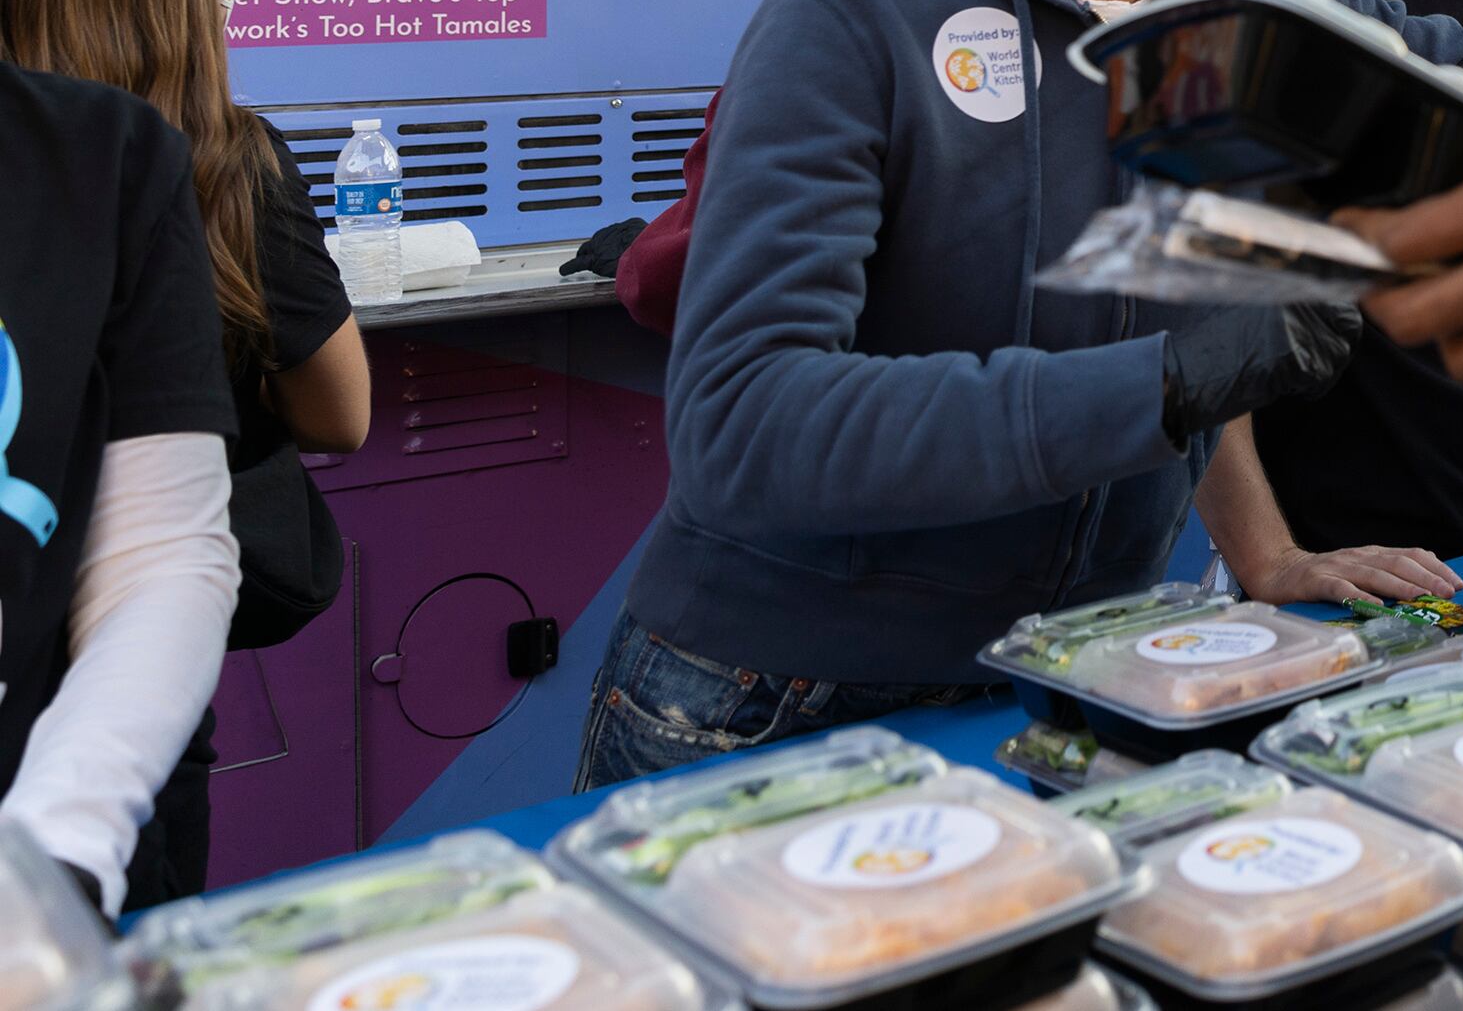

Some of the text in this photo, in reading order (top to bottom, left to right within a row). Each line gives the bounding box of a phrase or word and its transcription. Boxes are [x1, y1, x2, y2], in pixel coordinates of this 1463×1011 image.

[227, 11, 532, 40] work's Too Hot Tamales
[948, 28, 1020, 44] Provided by:
[987, 49, 1020, 62] World
[991, 63, 1021, 75] Centr
[994, 76, 1023, 87] Kitch
